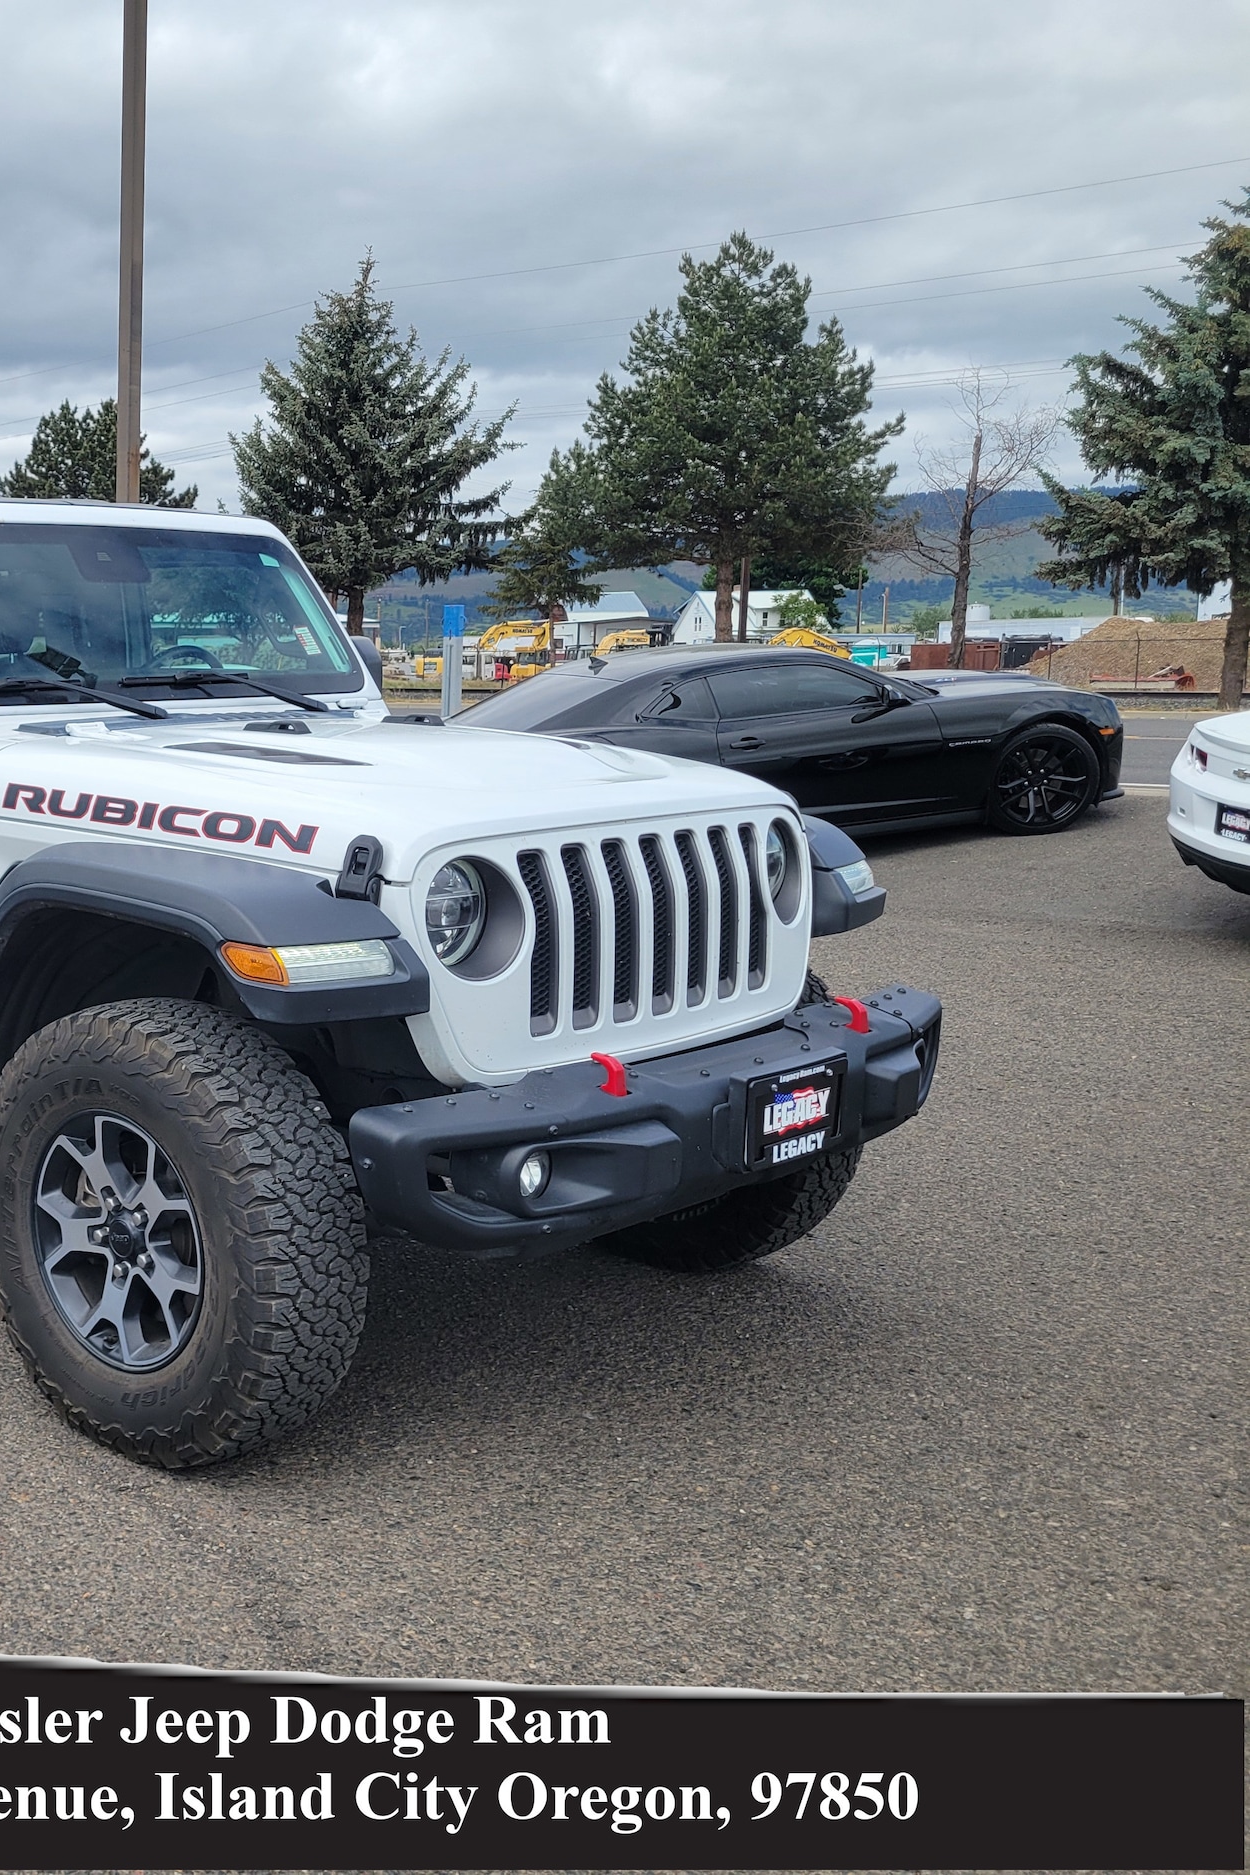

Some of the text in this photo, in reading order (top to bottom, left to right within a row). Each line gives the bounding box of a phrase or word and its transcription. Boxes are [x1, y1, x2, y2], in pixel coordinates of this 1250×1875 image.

[1, 782, 321, 855] RUBICON
[763, 1088, 831, 1134] LEGACY
[772, 1130, 826, 1164] LEGACY
